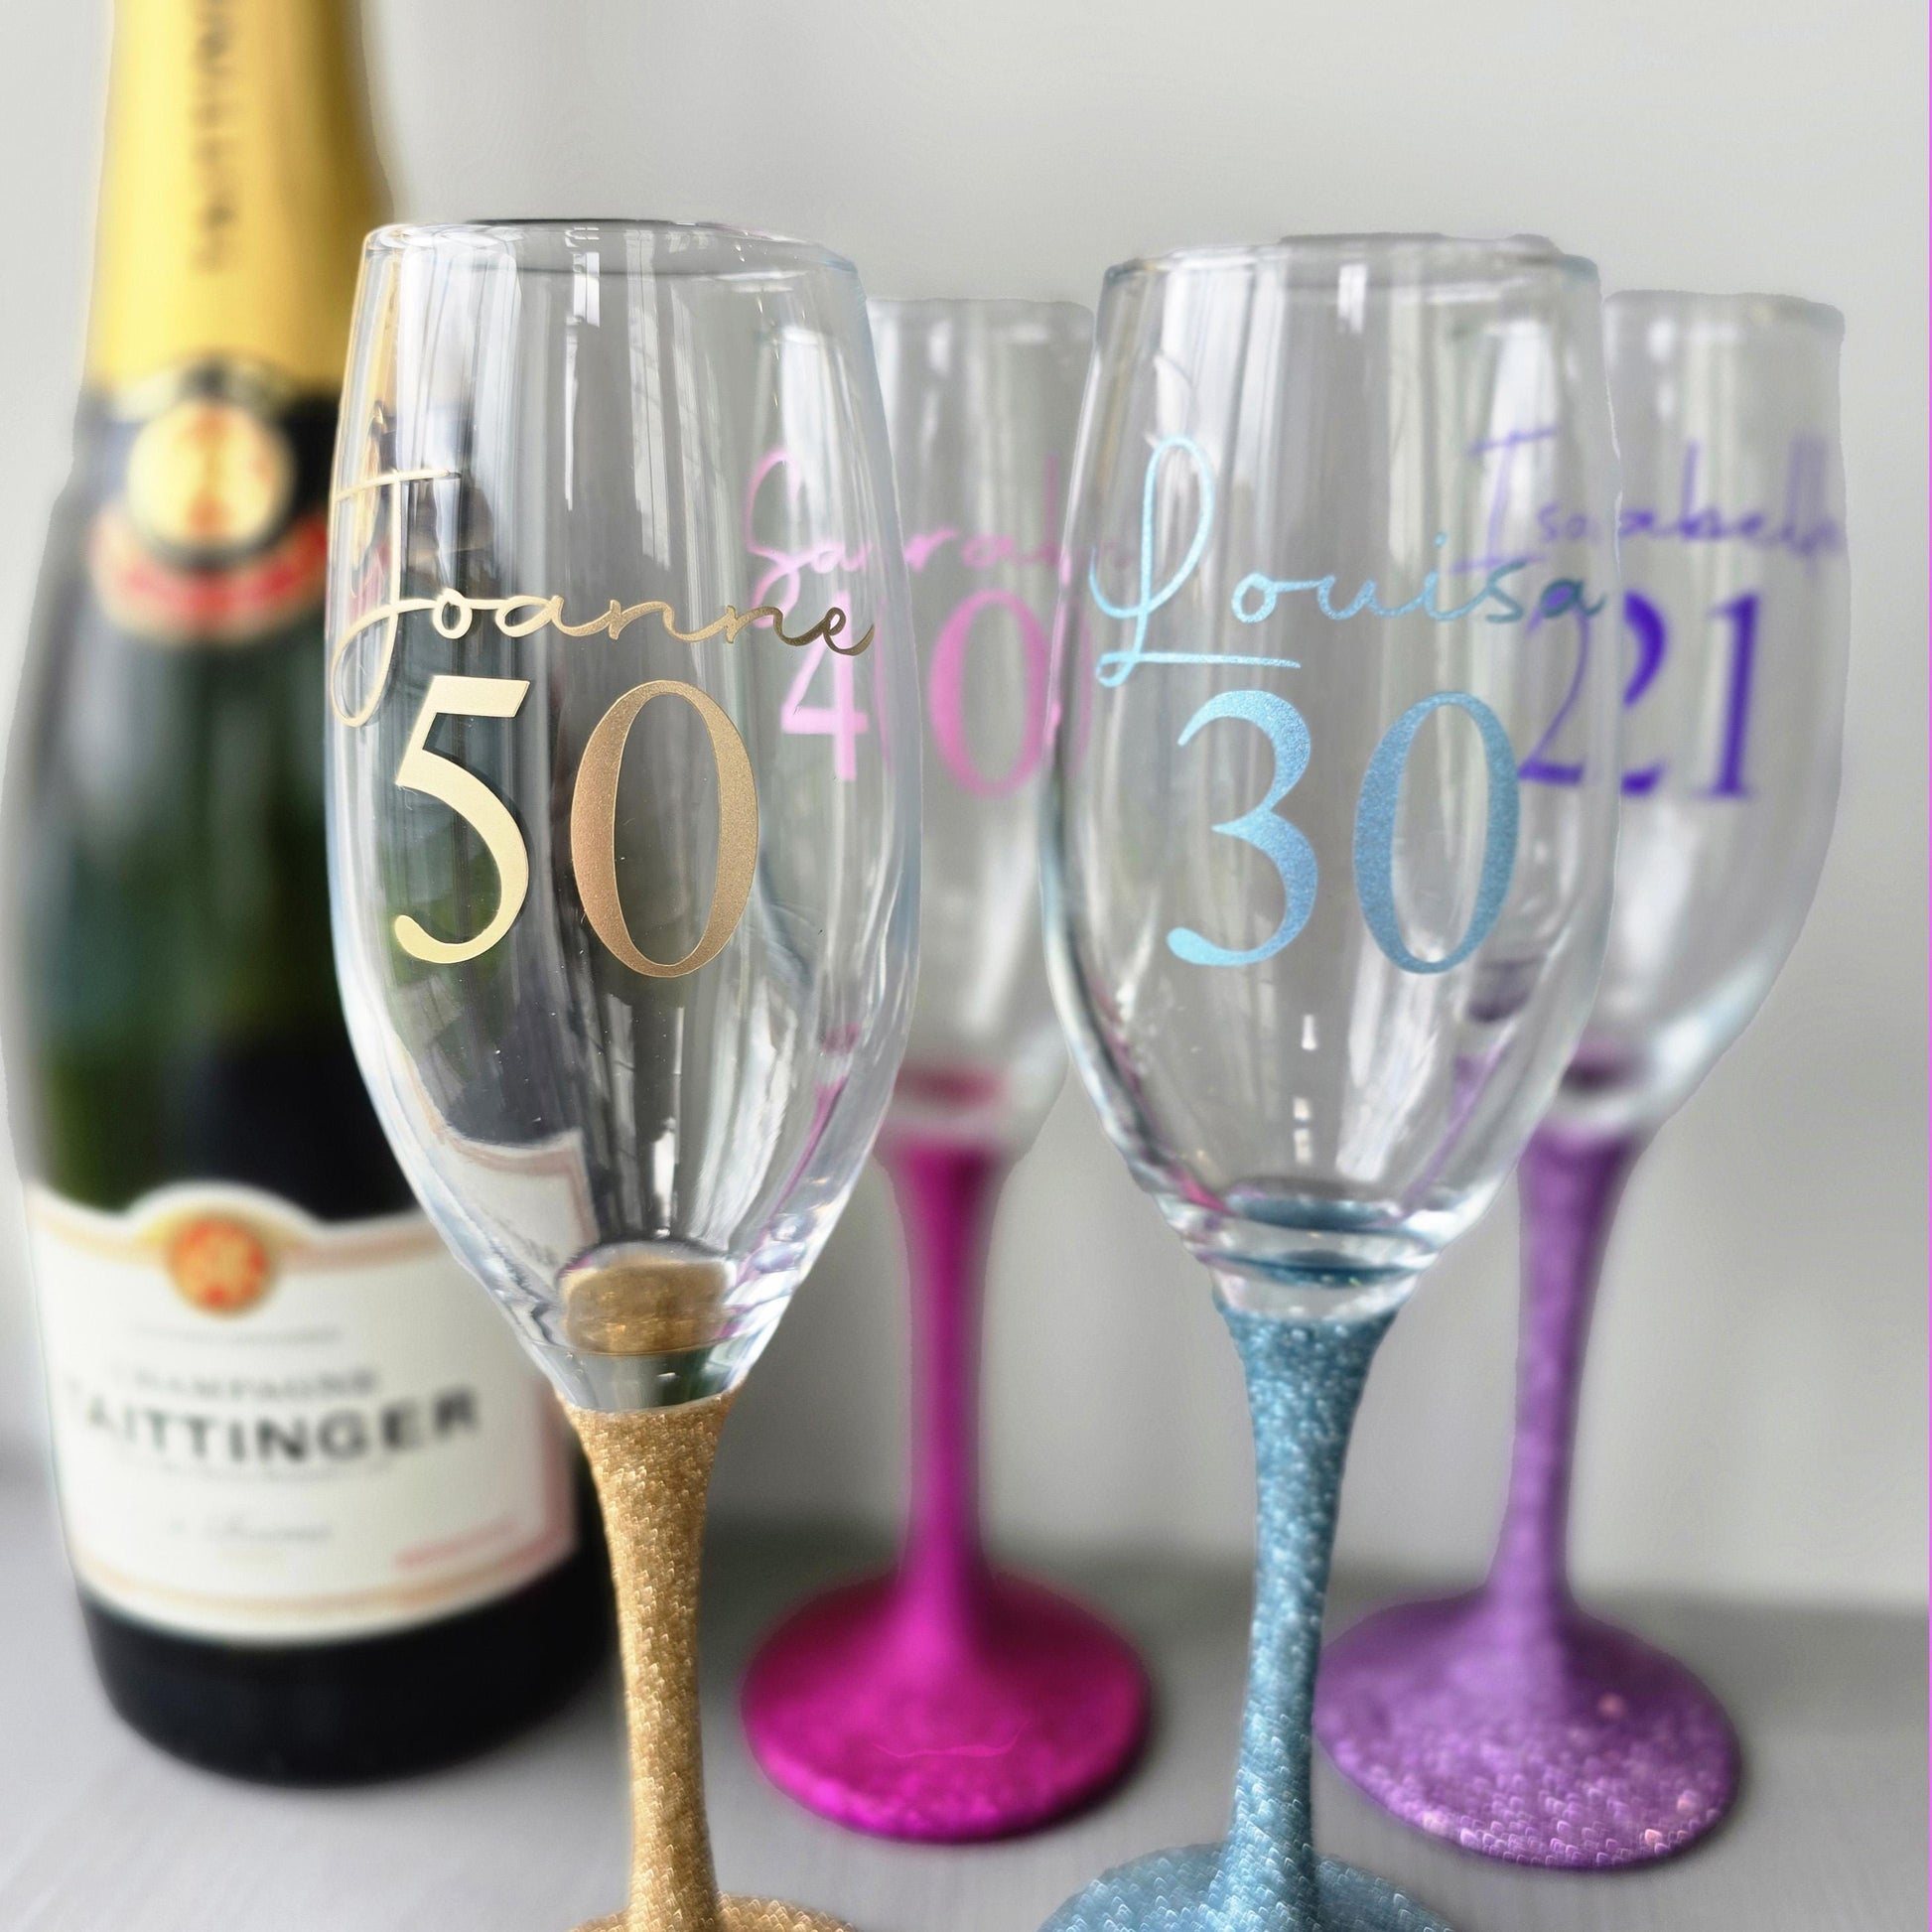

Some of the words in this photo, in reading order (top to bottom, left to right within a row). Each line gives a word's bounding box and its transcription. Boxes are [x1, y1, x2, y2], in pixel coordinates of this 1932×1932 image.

[330, 467, 876, 728] Joanne
[1089, 435, 1606, 687] Louisa
[780, 590, 1064, 798] 40
[394, 675, 759, 978] 50
[1166, 689, 1521, 975] 30
